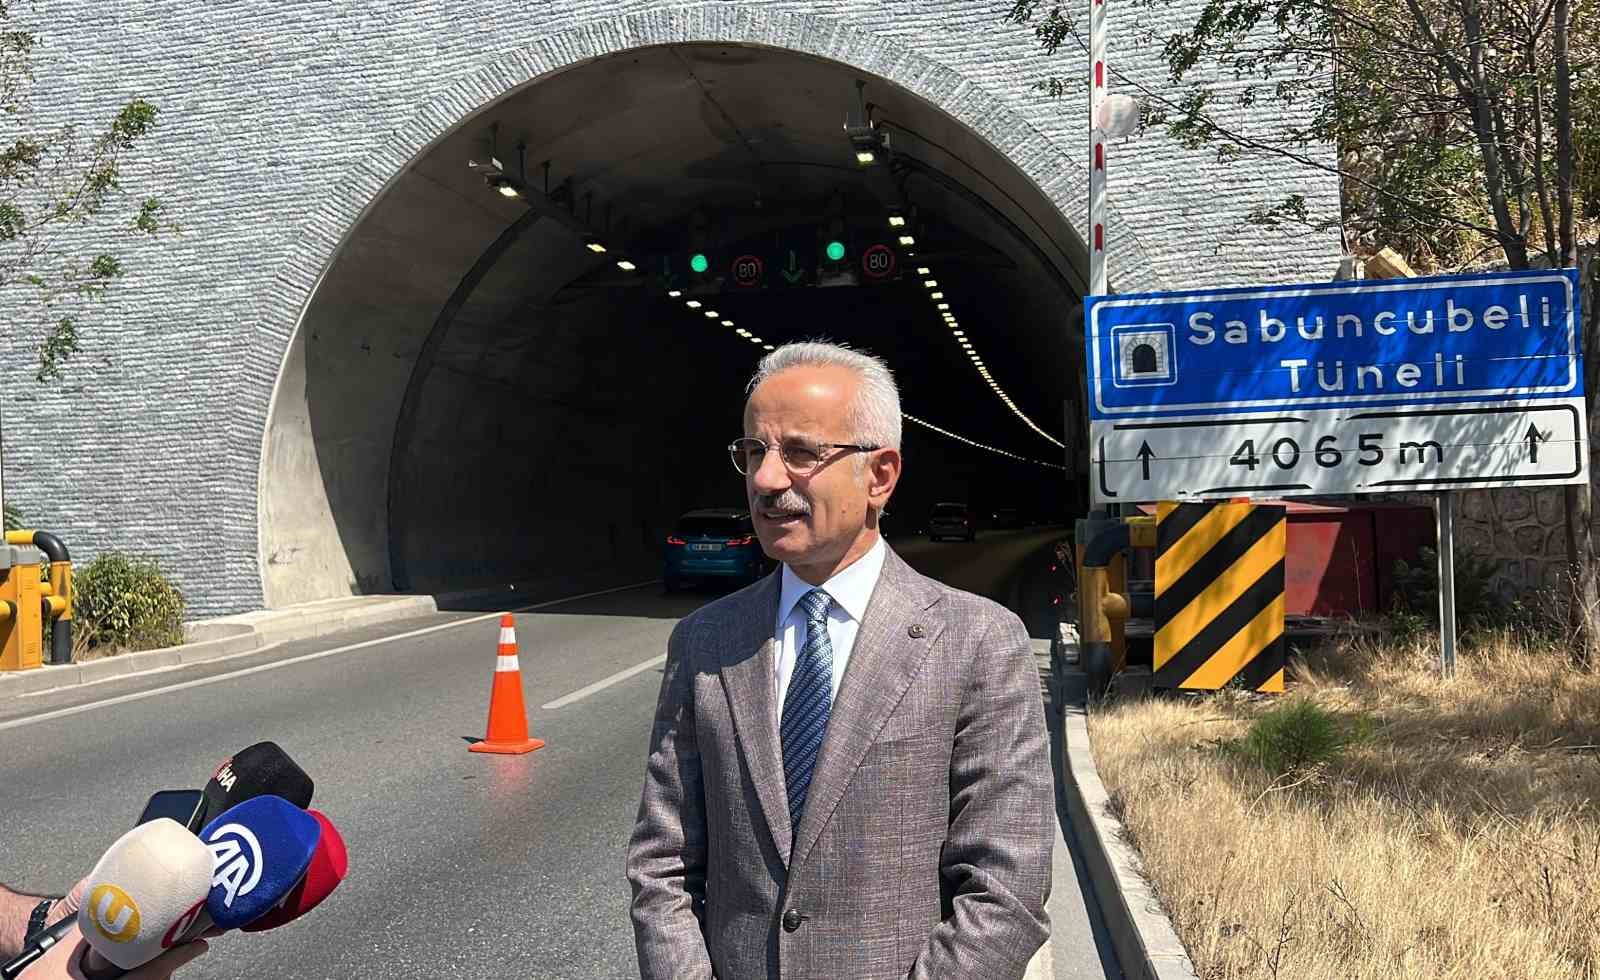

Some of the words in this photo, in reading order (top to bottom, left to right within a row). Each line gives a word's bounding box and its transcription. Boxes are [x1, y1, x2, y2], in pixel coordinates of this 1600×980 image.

[739, 262, 756, 279] 80
[870, 253, 888, 269] 80
[1188, 295, 1551, 346] Sabuncubeli
[1281, 353, 1466, 393] Tüneli
[207, 839, 249, 908] AA
